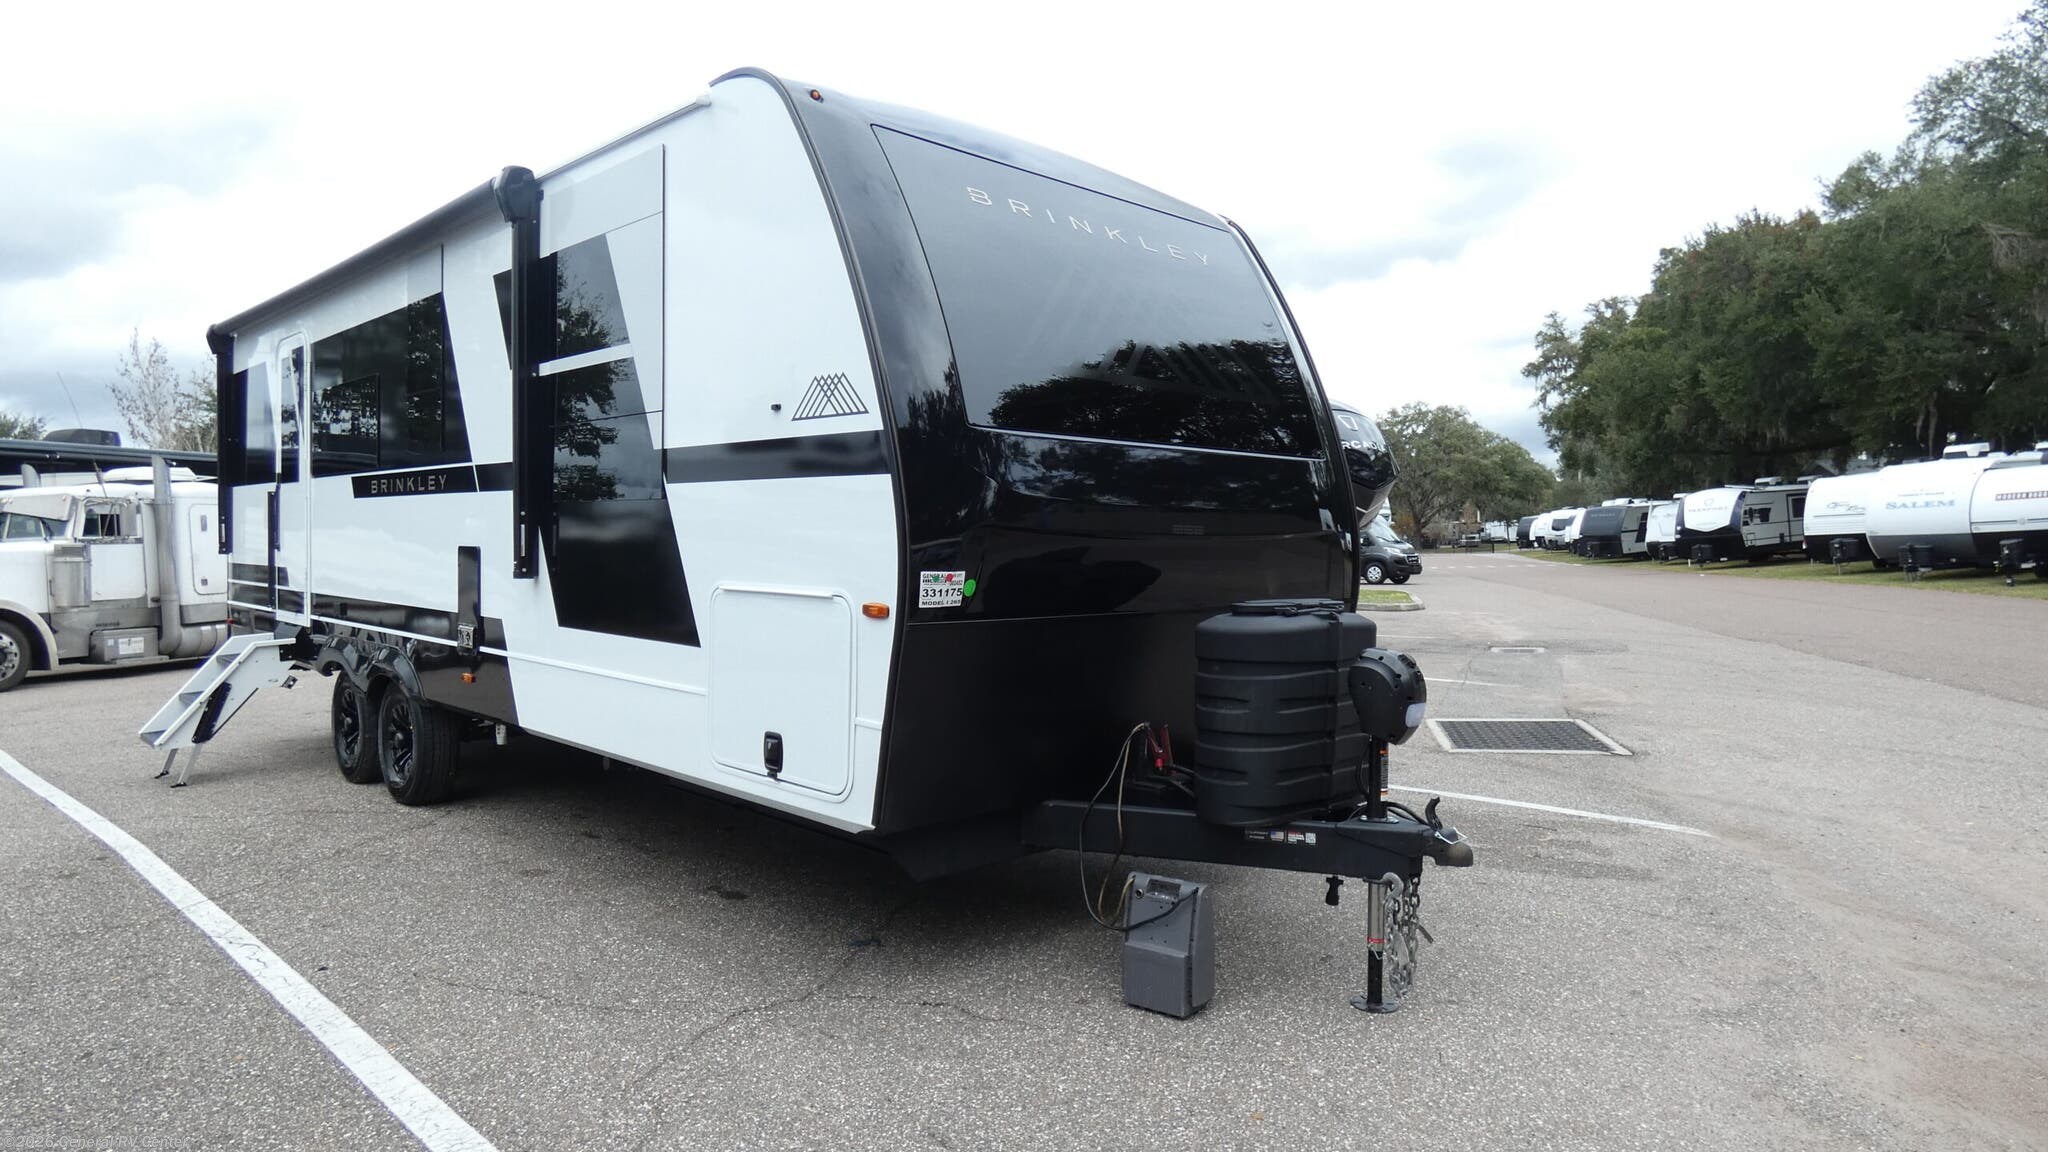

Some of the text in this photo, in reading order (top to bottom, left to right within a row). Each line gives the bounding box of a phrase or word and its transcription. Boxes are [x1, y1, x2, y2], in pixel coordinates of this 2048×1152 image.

[966, 186, 1208, 265] BRINKLEY
[371, 474, 447, 494] BRINKLEY
[1885, 500, 1955, 510] SALEM
[922, 588, 963, 597] 331175
